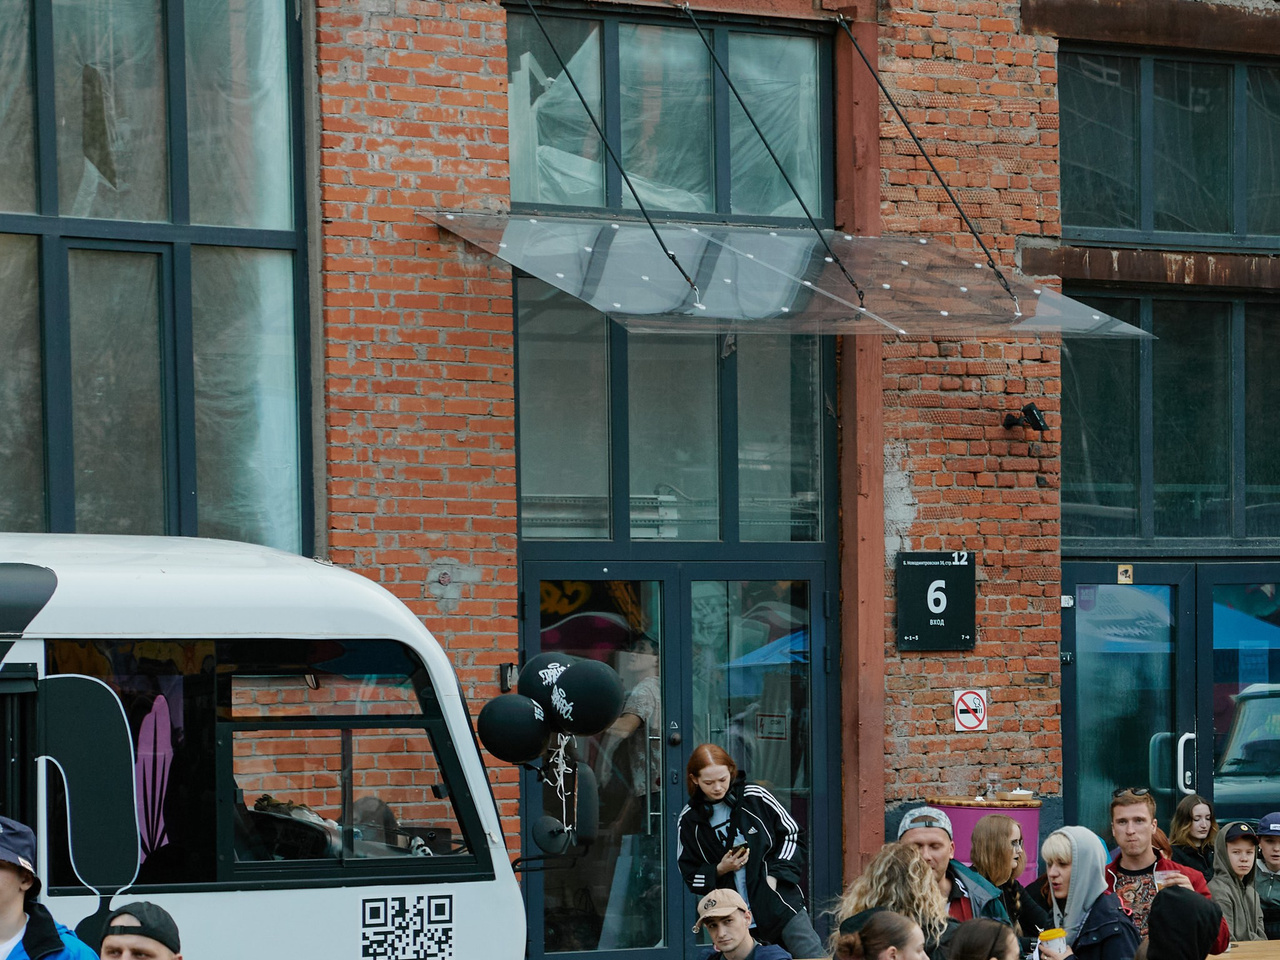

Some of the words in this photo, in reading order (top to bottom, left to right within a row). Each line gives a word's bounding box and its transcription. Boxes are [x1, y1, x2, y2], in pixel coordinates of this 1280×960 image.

[952, 551, 968, 565] 12
[927, 580, 947, 614] 6
[929, 619, 945, 627] ВХОД
